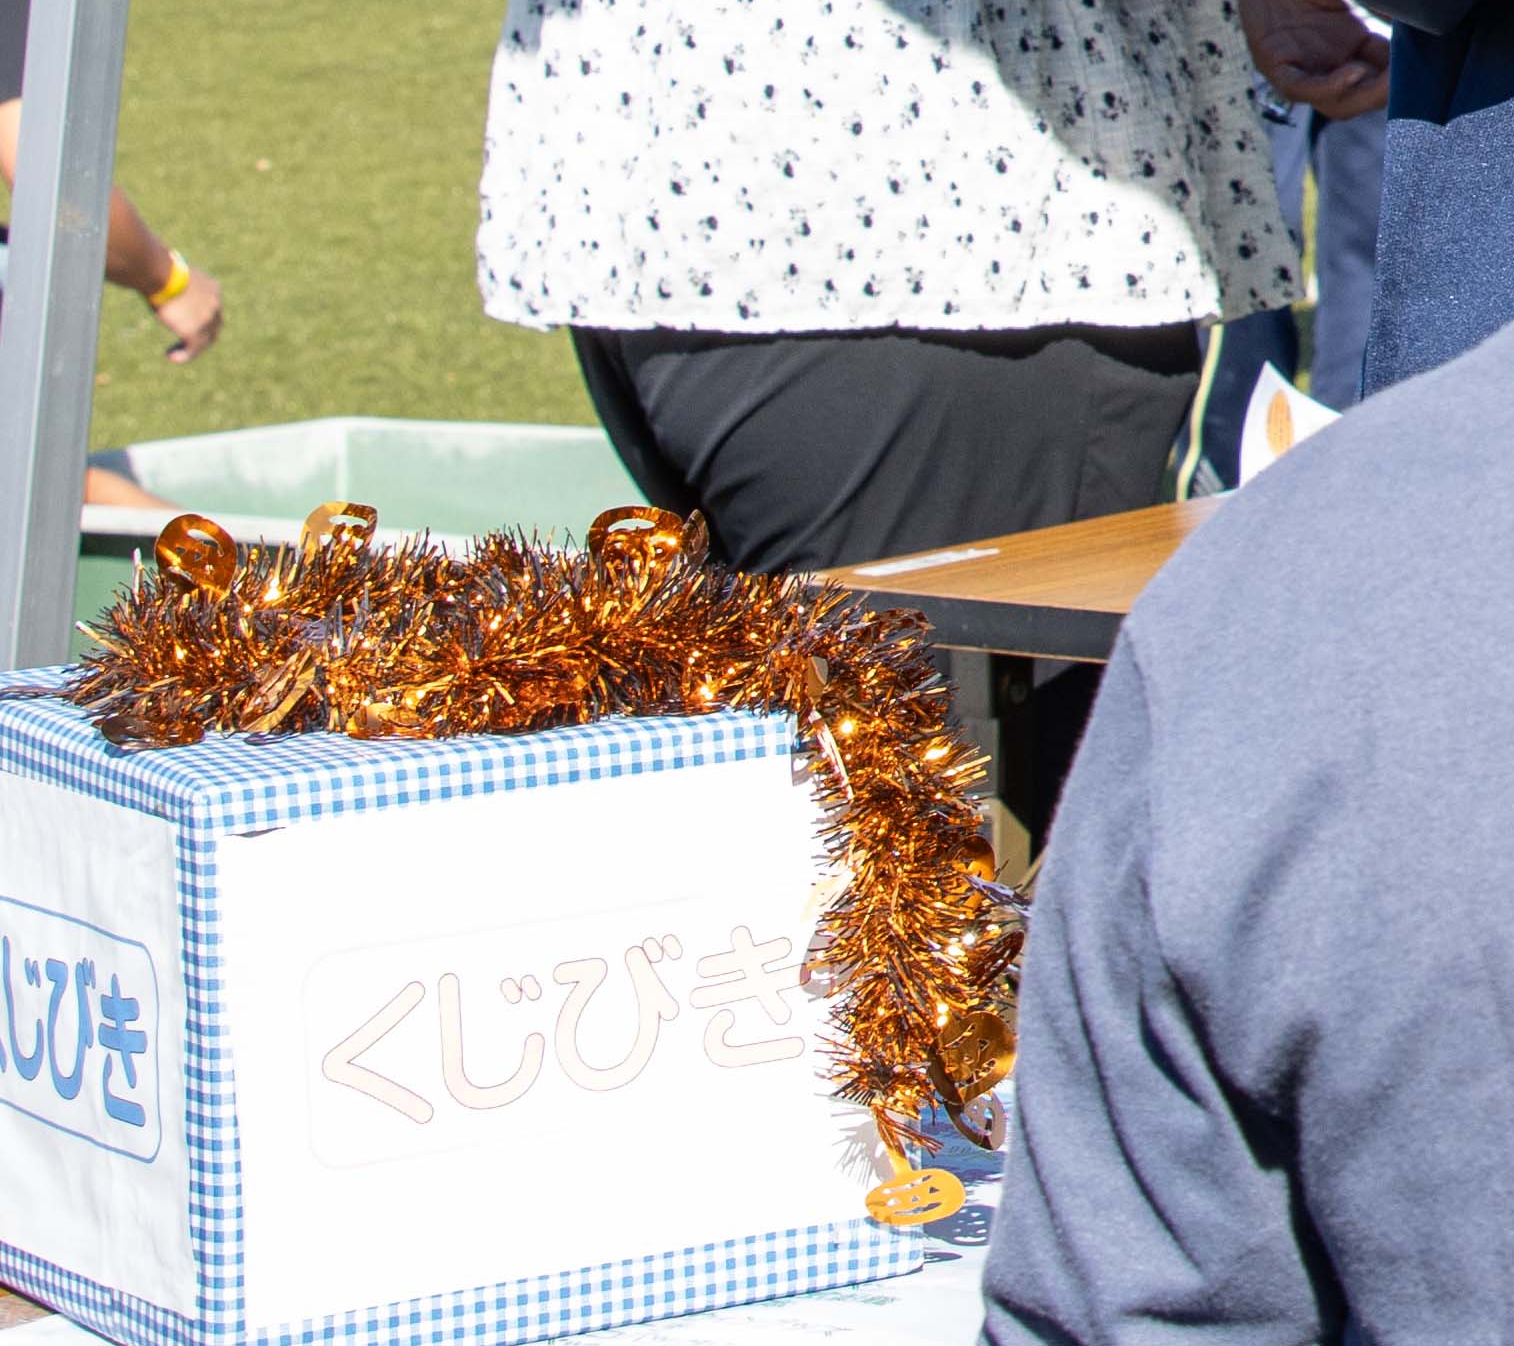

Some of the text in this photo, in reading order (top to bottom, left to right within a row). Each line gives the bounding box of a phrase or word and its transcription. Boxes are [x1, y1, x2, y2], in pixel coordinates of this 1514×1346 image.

[0, 936, 147, 1128] じびき
[321, 924, 805, 1124] くじびき
